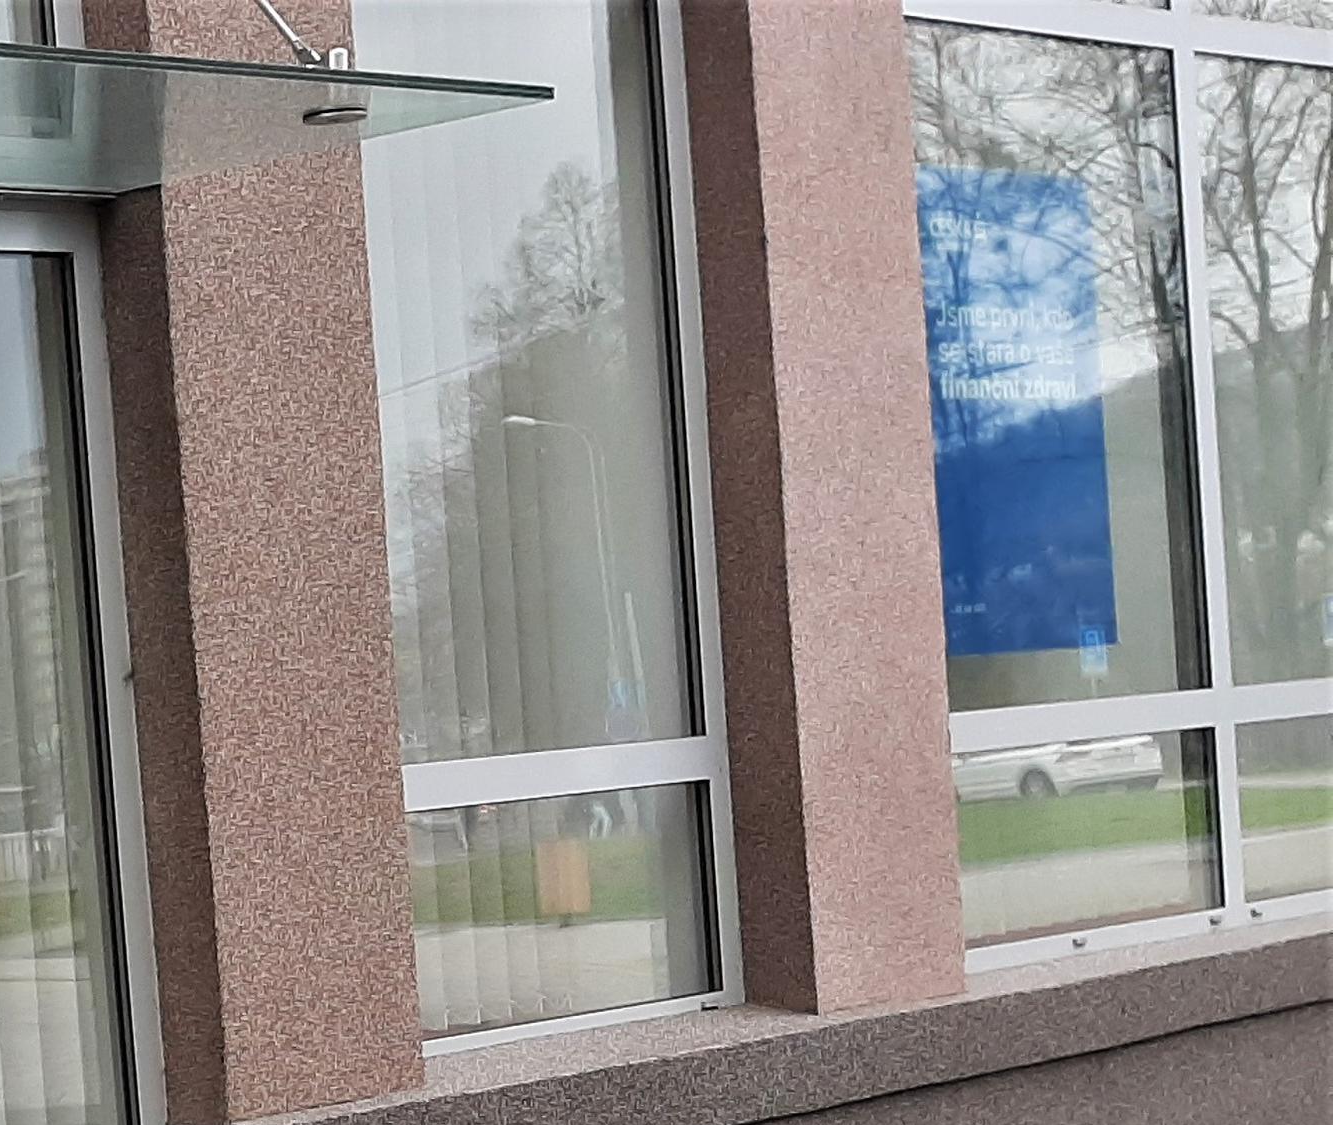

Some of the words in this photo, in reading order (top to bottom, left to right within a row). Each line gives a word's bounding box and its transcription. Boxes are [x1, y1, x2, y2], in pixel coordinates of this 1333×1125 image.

[936, 300, 987, 329] Jsme
[938, 342, 964, 363] se
[1020, 343, 1030, 361] o
